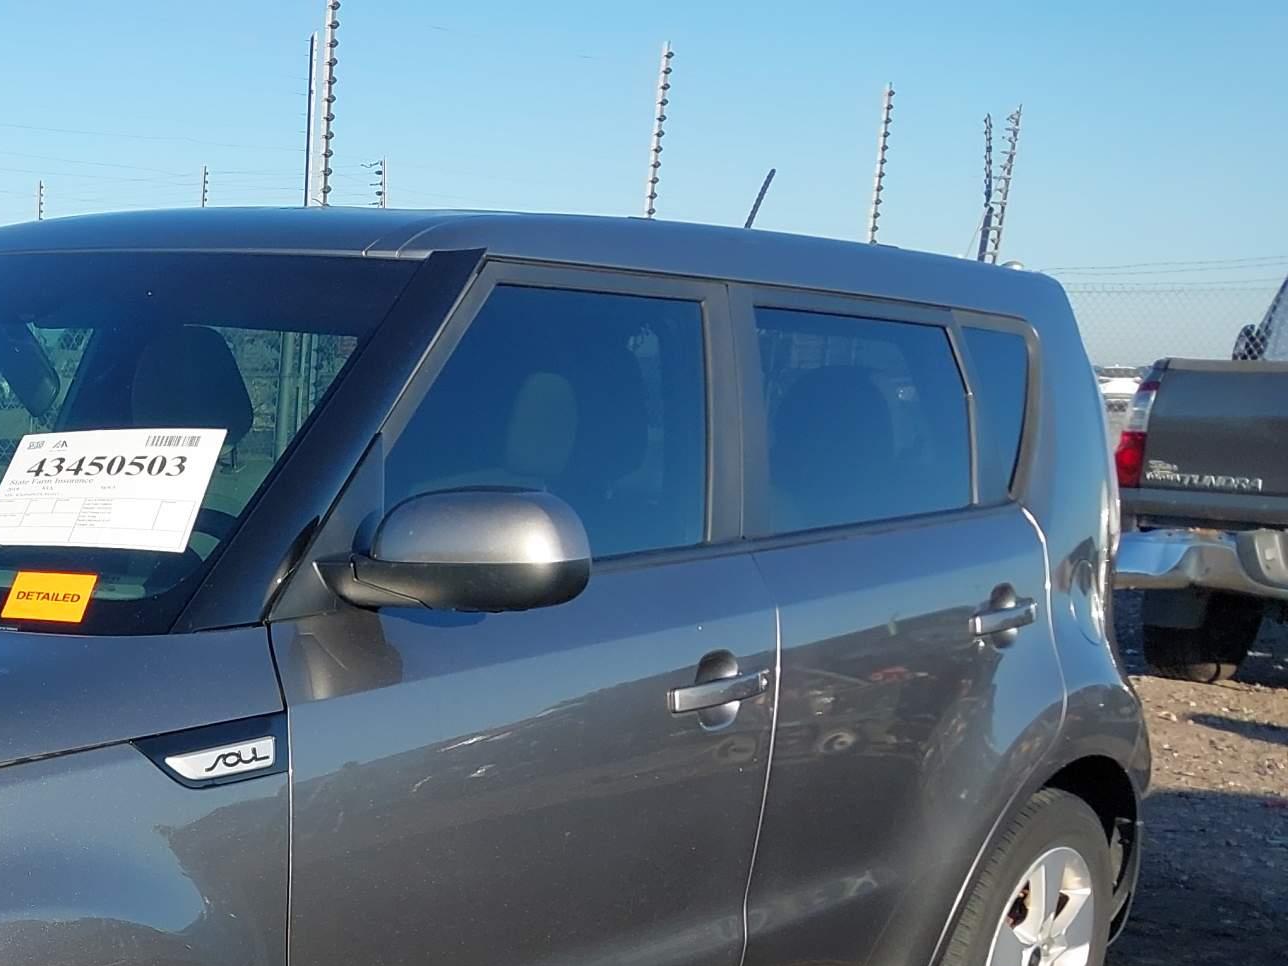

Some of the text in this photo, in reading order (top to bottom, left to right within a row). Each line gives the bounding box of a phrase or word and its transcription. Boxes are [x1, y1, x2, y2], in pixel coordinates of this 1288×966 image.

[26, 455, 188, 477] 43450503
[54, 477, 95, 485] Insurance
[16, 591, 81, 603] DETAILED
